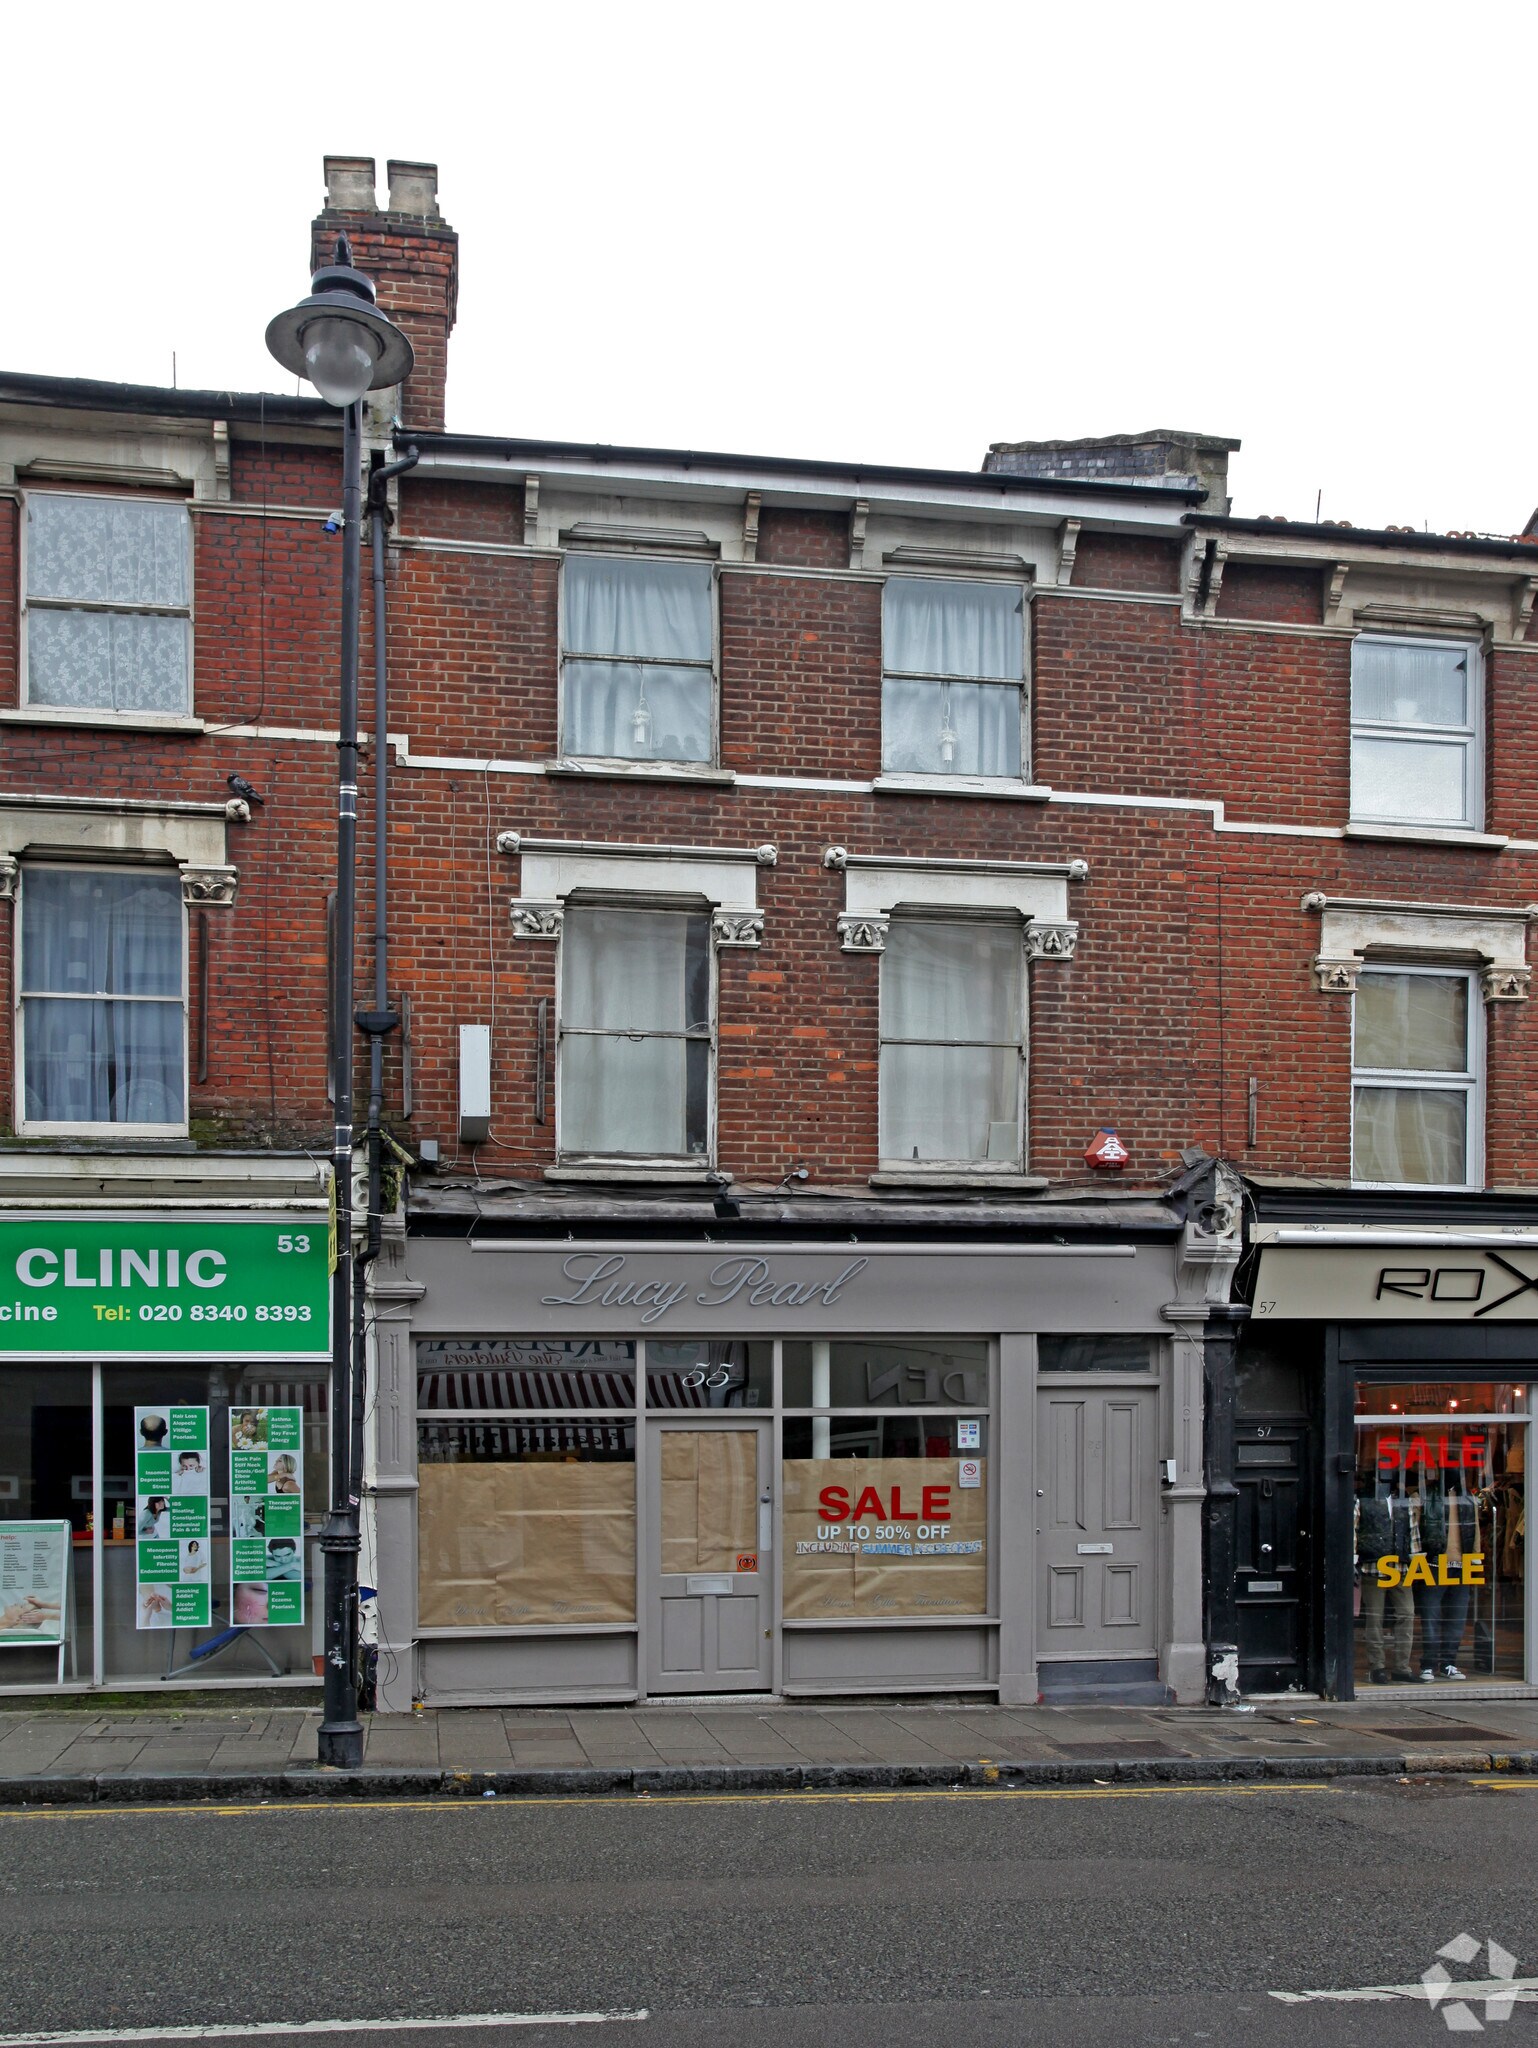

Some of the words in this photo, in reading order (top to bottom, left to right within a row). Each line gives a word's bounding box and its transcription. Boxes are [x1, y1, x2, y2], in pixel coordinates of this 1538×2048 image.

[277, 1234, 311, 1253] 53
[16, 1247, 228, 1288] CLINIC
[541, 1253, 690, 1323] Lucy
[696, 1255, 870, 1307] Pearl
[93, 1305, 131, 1321] Tel:
[139, 1305, 183, 1321] 020
[190, 1305, 248, 1321] 8340
[255, 1305, 312, 1321] 8393
[1259, 1302, 1276, 1314] 57
[682, 1362, 734, 1388] 55
[1257, 1426, 1271, 1437] 57
[1377, 1436, 1485, 1469] SALE
[817, 1486, 951, 1522] SALE
[817, 1526, 841, 1540] UP
[847, 1526, 870, 1540] TO
[875, 1526, 911, 1540] 50%
[917, 1525, 950, 1539] OFF
[862, 1544, 912, 1555] SUMMER
[1376, 1553, 1485, 1588] SALE
